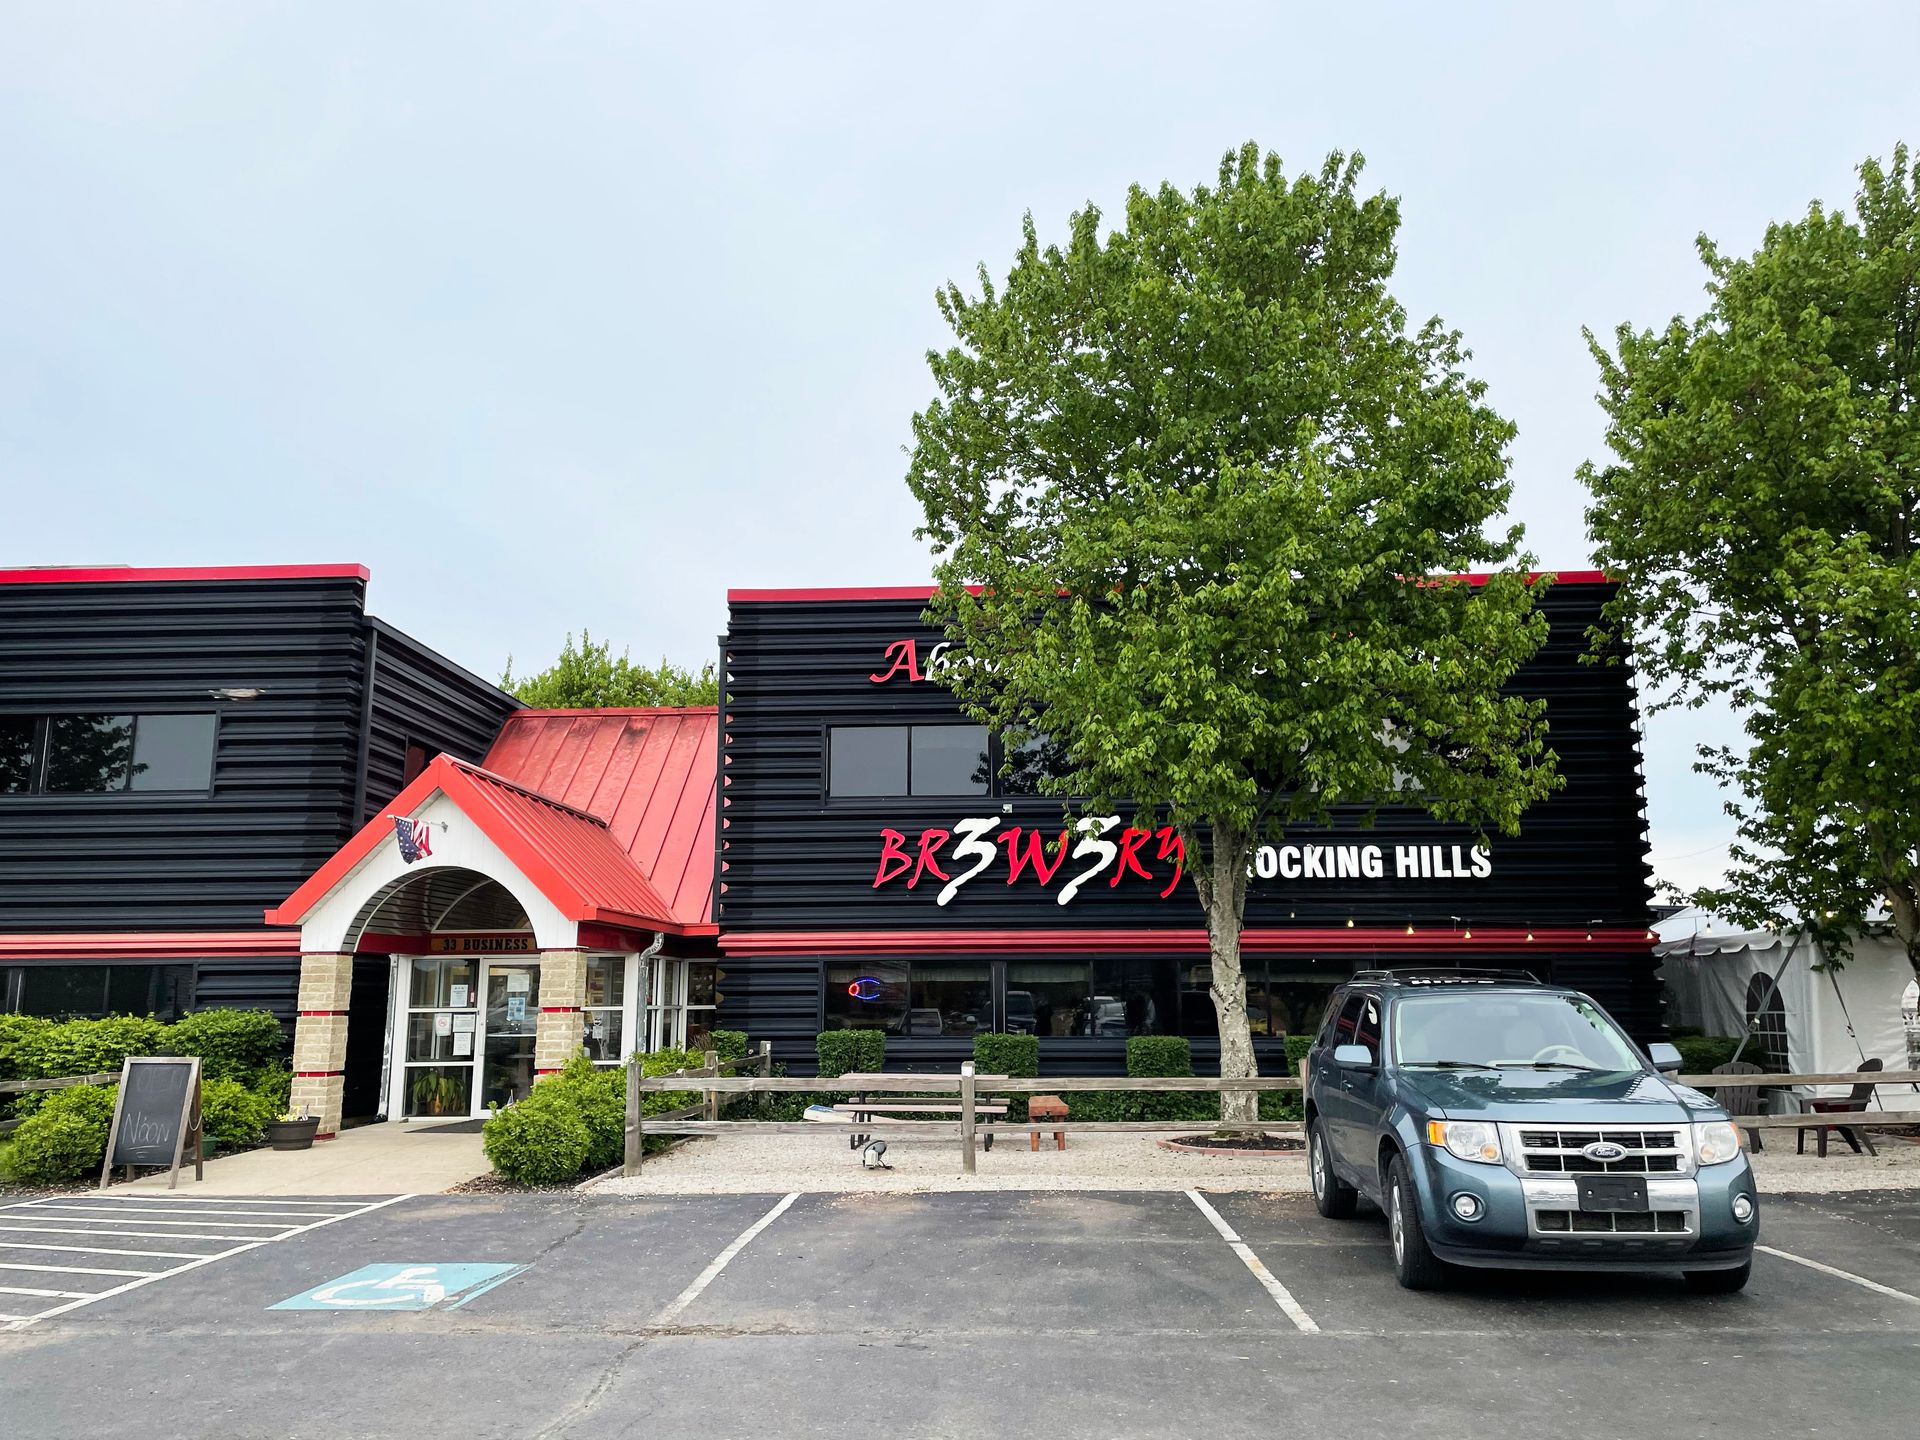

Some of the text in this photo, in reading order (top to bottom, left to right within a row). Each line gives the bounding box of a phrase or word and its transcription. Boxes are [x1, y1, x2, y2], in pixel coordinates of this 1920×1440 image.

[1246, 844, 1492, 879] OCKING HILLS
[443, 938, 529, 951] 33 BUSINESS
